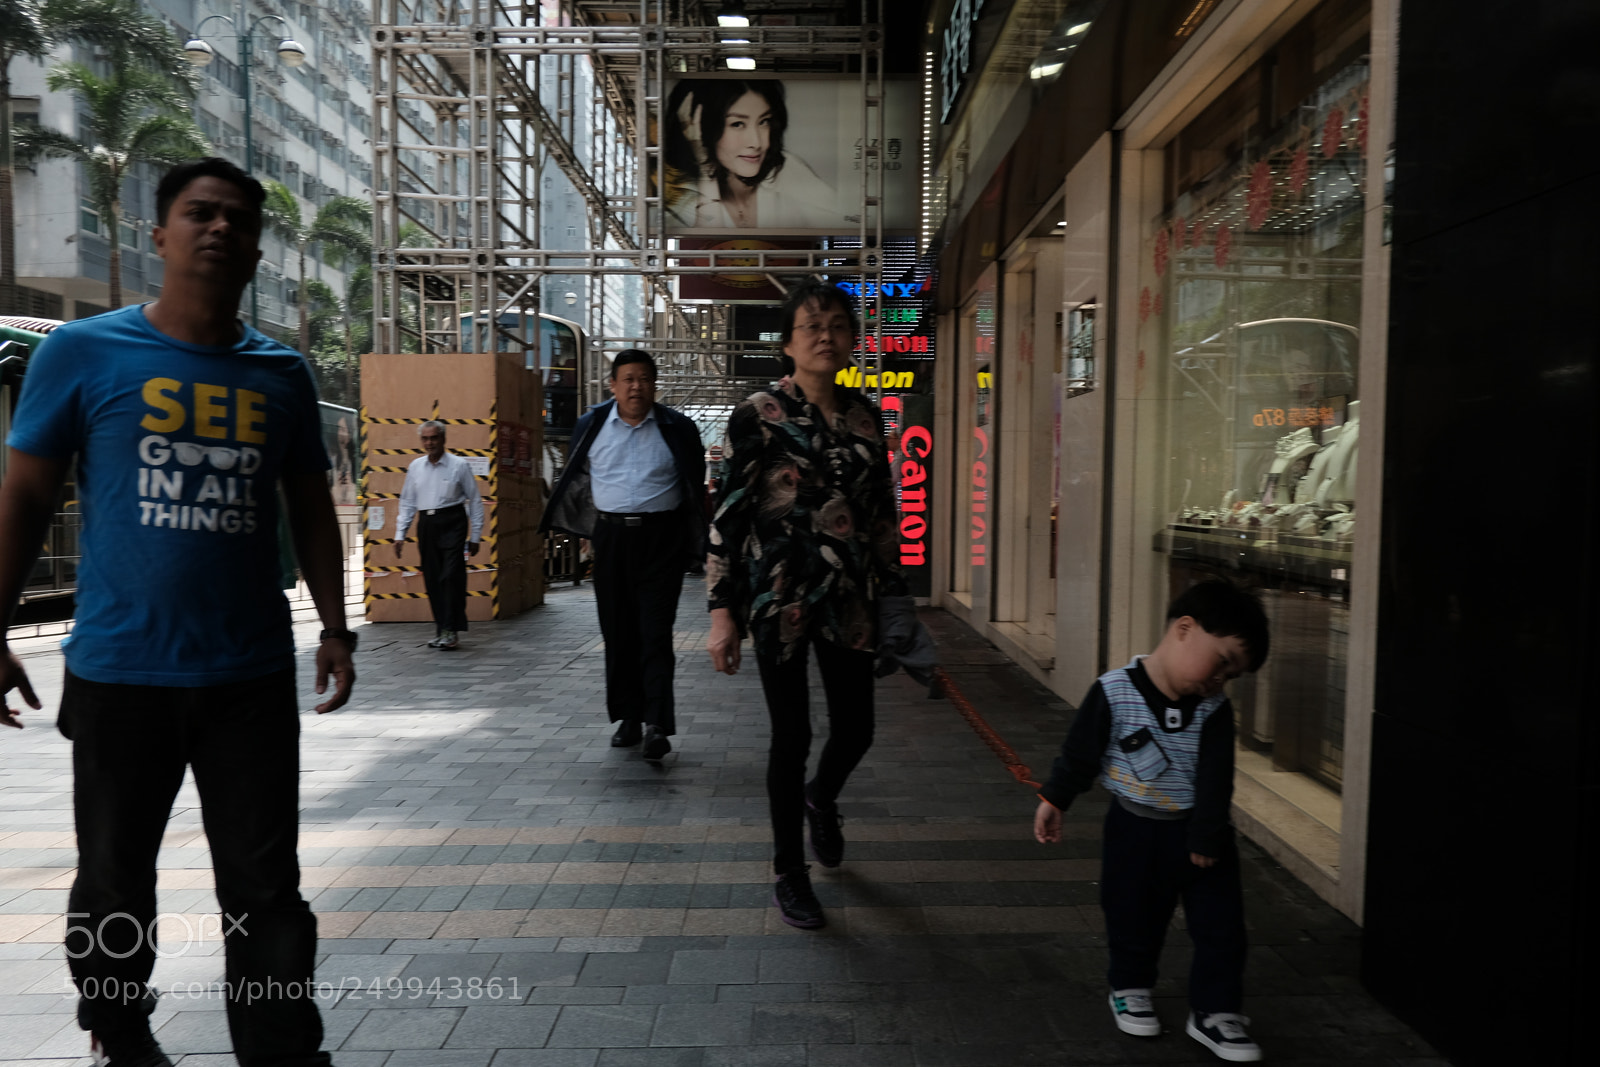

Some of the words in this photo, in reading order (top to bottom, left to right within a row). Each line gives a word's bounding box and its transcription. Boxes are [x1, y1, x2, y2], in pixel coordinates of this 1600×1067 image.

[853, 335, 928, 353] anon
[140, 377, 268, 445] SEE
[138, 467, 184, 501] IN
[195, 474, 258, 507] ALL
[900, 425, 933, 566] Canon
[138, 501, 258, 534] THINGS
